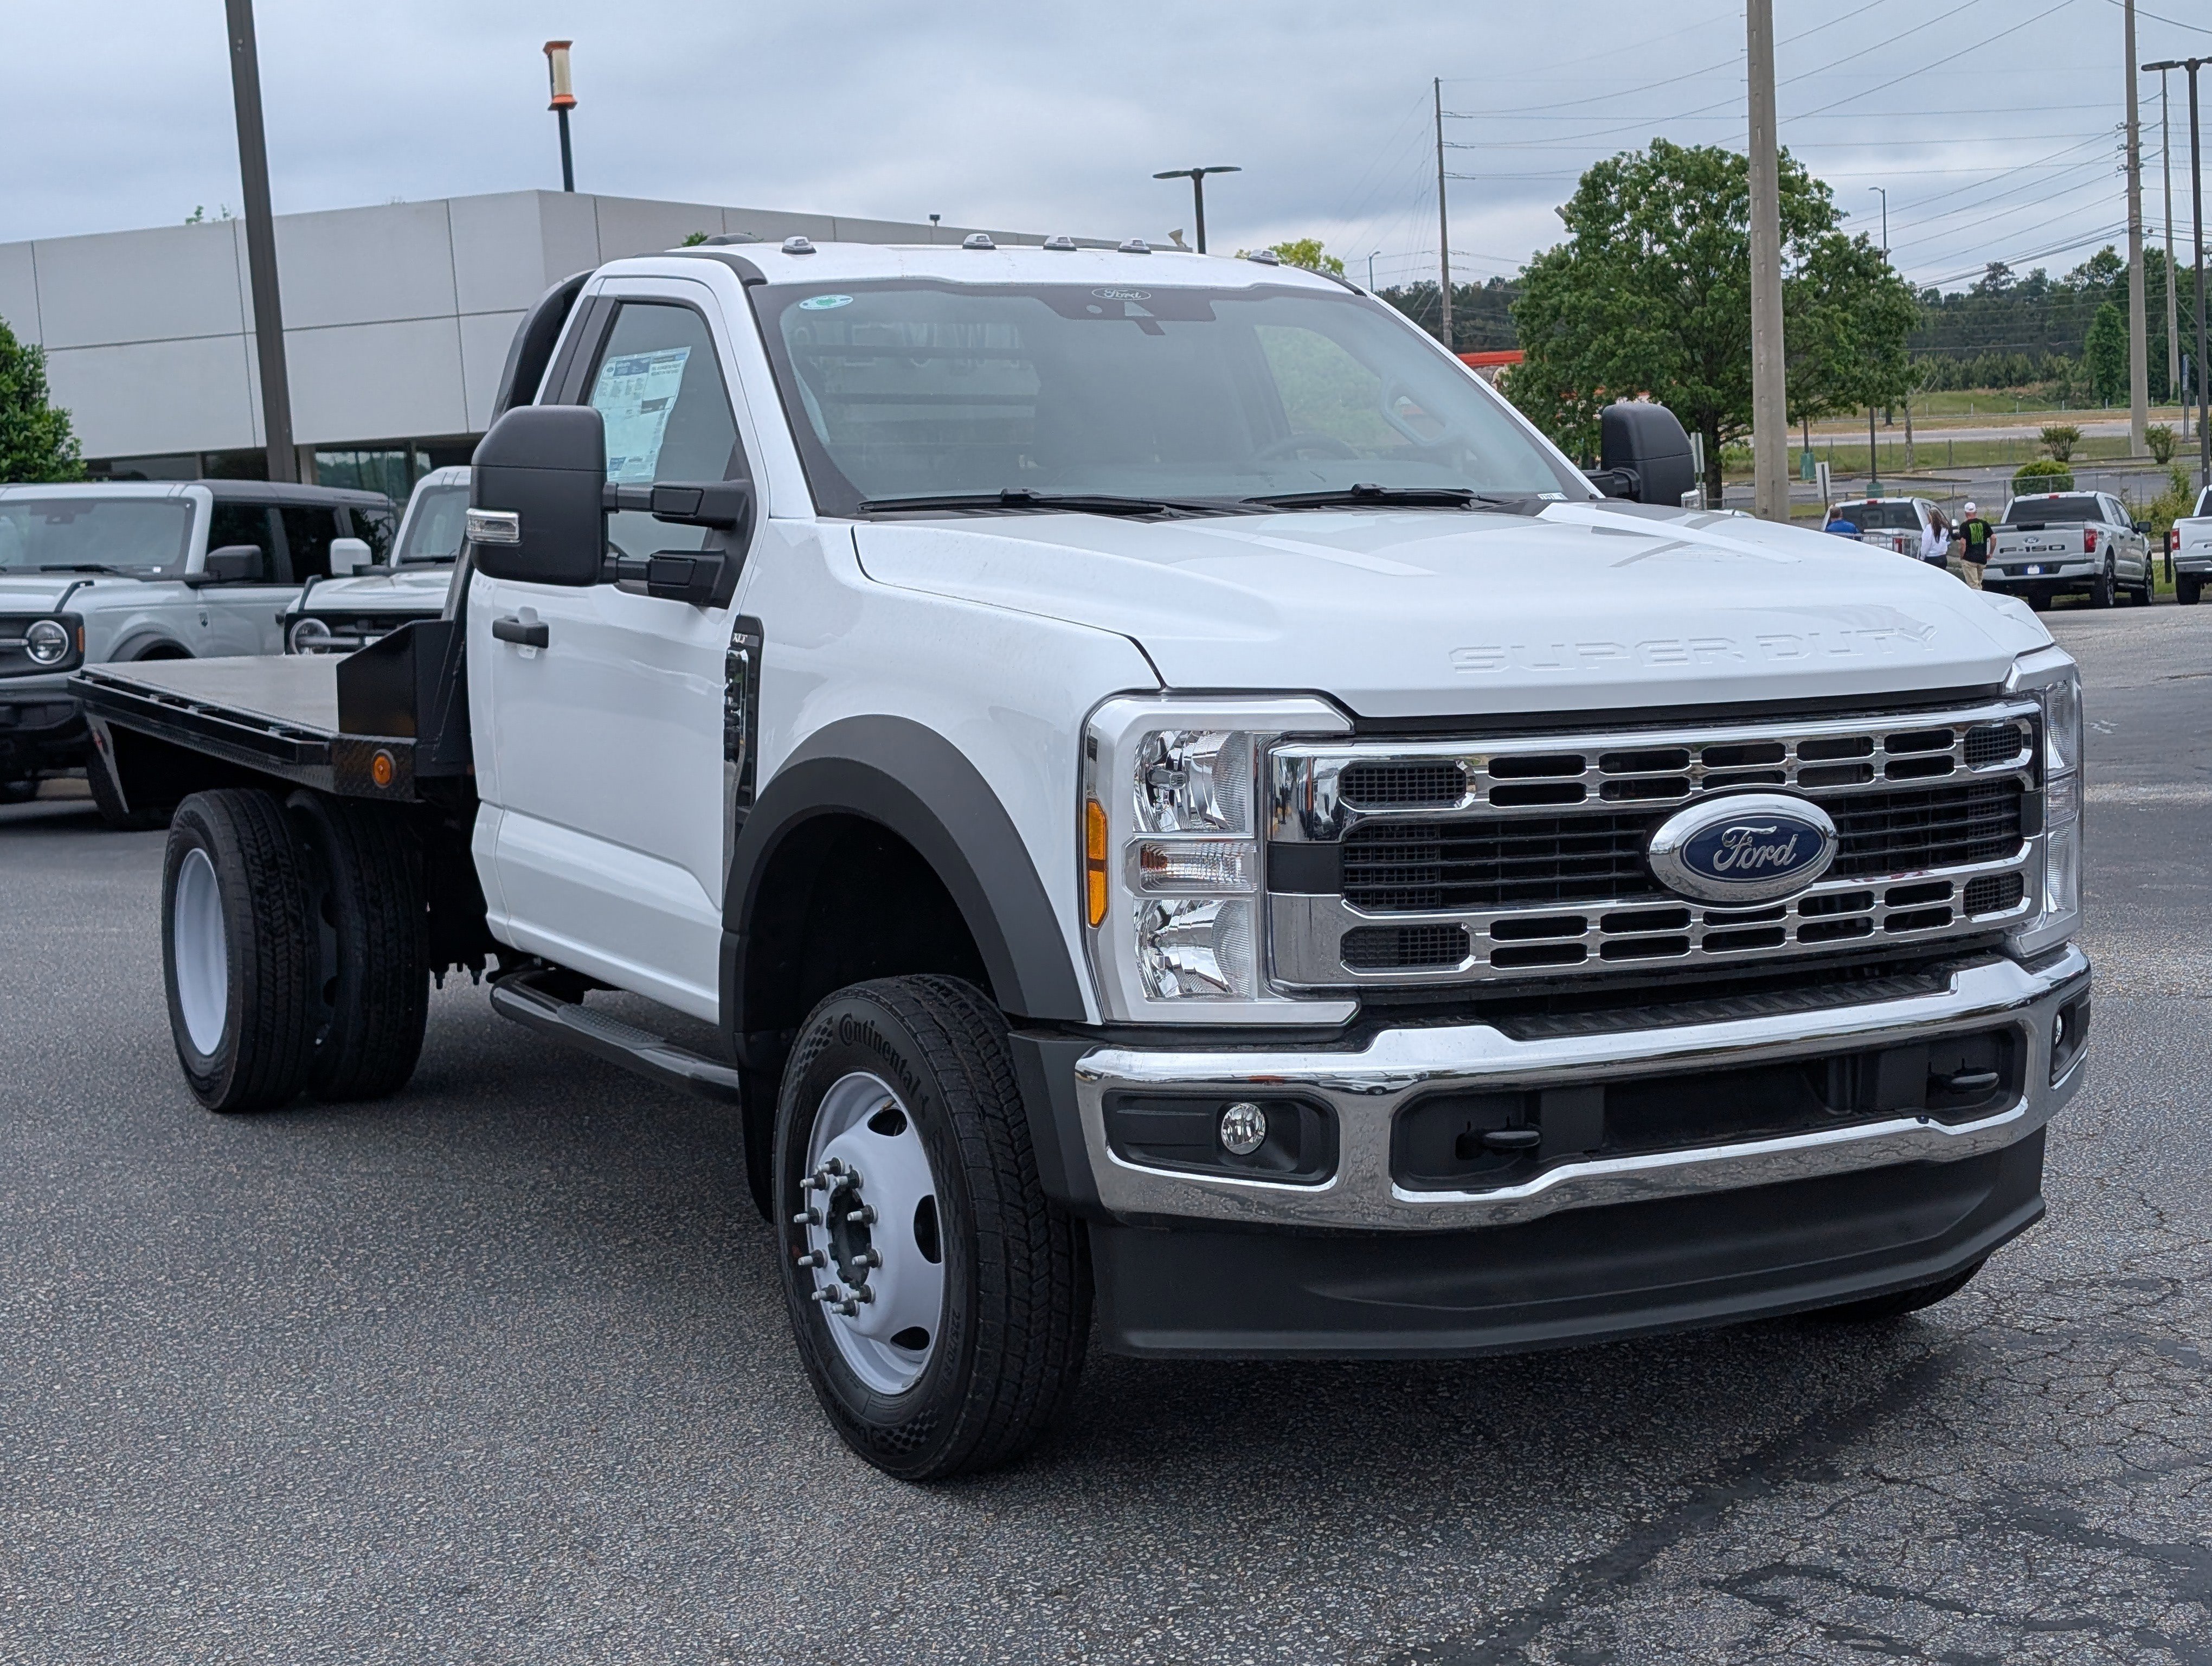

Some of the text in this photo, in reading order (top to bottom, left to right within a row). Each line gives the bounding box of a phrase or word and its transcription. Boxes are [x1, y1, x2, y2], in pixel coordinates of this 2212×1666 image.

[1103, 289, 1141, 299] Ford
[1999, 544, 2066, 554] F-150
[732, 632, 748, 644] XLT
[1448, 625, 1939, 674] SUPER DUTY
[1713, 825, 1798, 872] Ford
[839, 1012, 922, 1099] Continental
